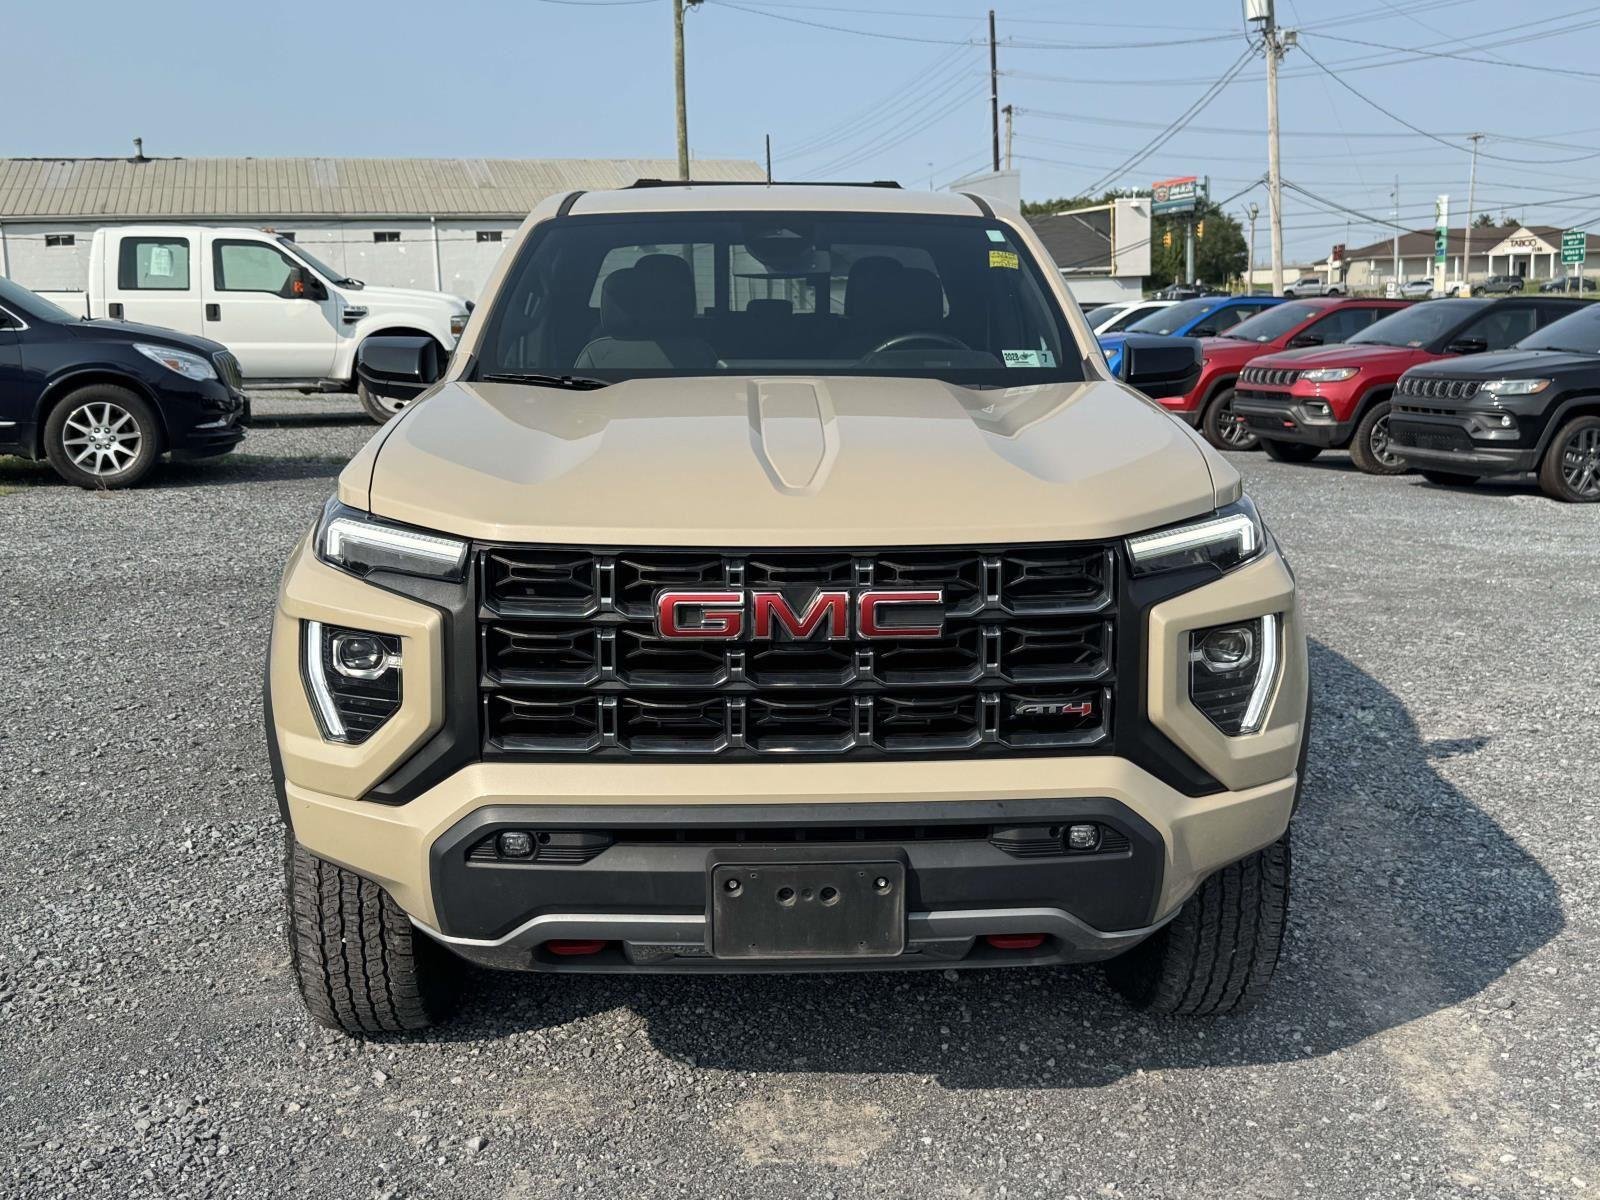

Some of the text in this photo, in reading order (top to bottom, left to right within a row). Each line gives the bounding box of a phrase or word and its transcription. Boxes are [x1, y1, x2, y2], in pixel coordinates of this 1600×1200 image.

[1511, 239, 1537, 247] TABOO
[1041, 353, 1048, 363] 7
[657, 589, 944, 641] GMC
[1015, 702, 1092, 717] AT4
